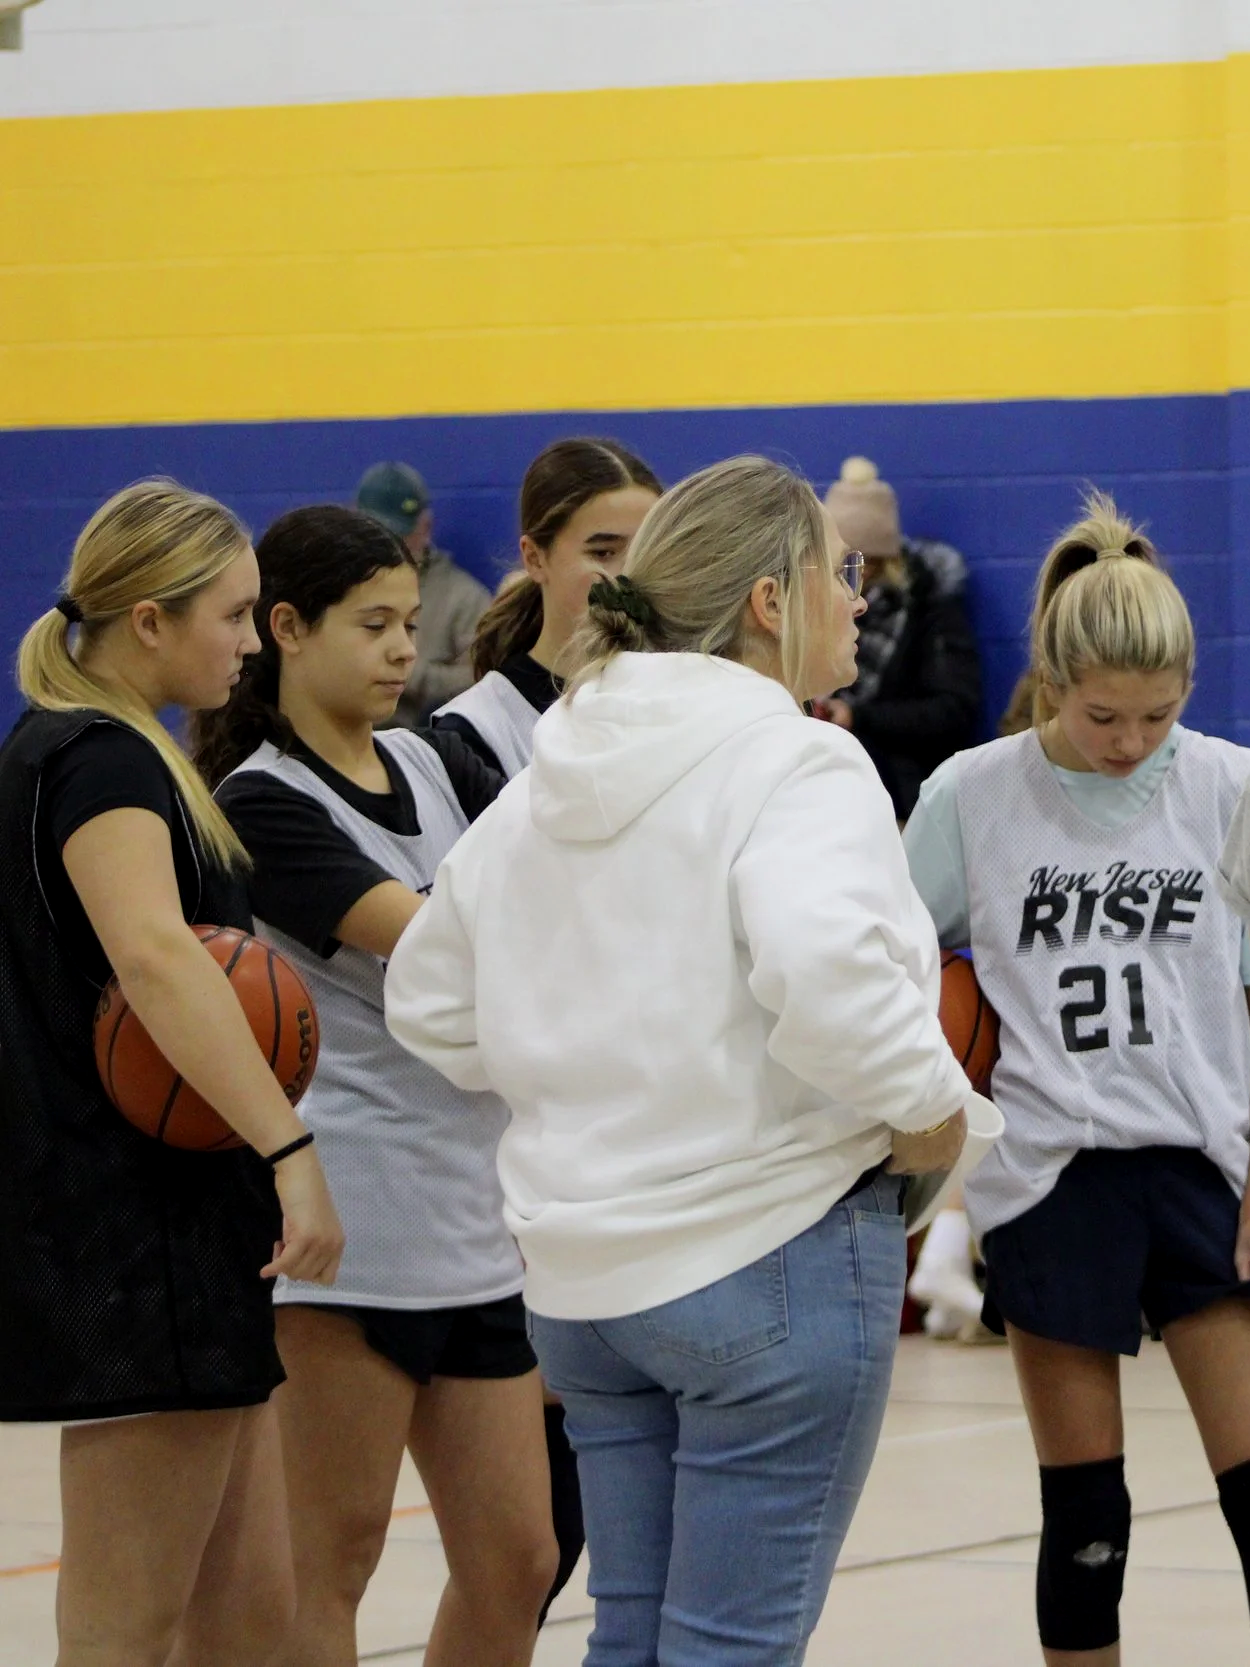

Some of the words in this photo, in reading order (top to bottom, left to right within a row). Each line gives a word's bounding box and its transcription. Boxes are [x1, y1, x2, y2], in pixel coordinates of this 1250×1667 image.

[1030, 864, 1098, 898] New
[1098, 860, 1204, 898] Jersey
[1014, 889, 1204, 957] RISE
[1058, 961, 1154, 1053] 21
